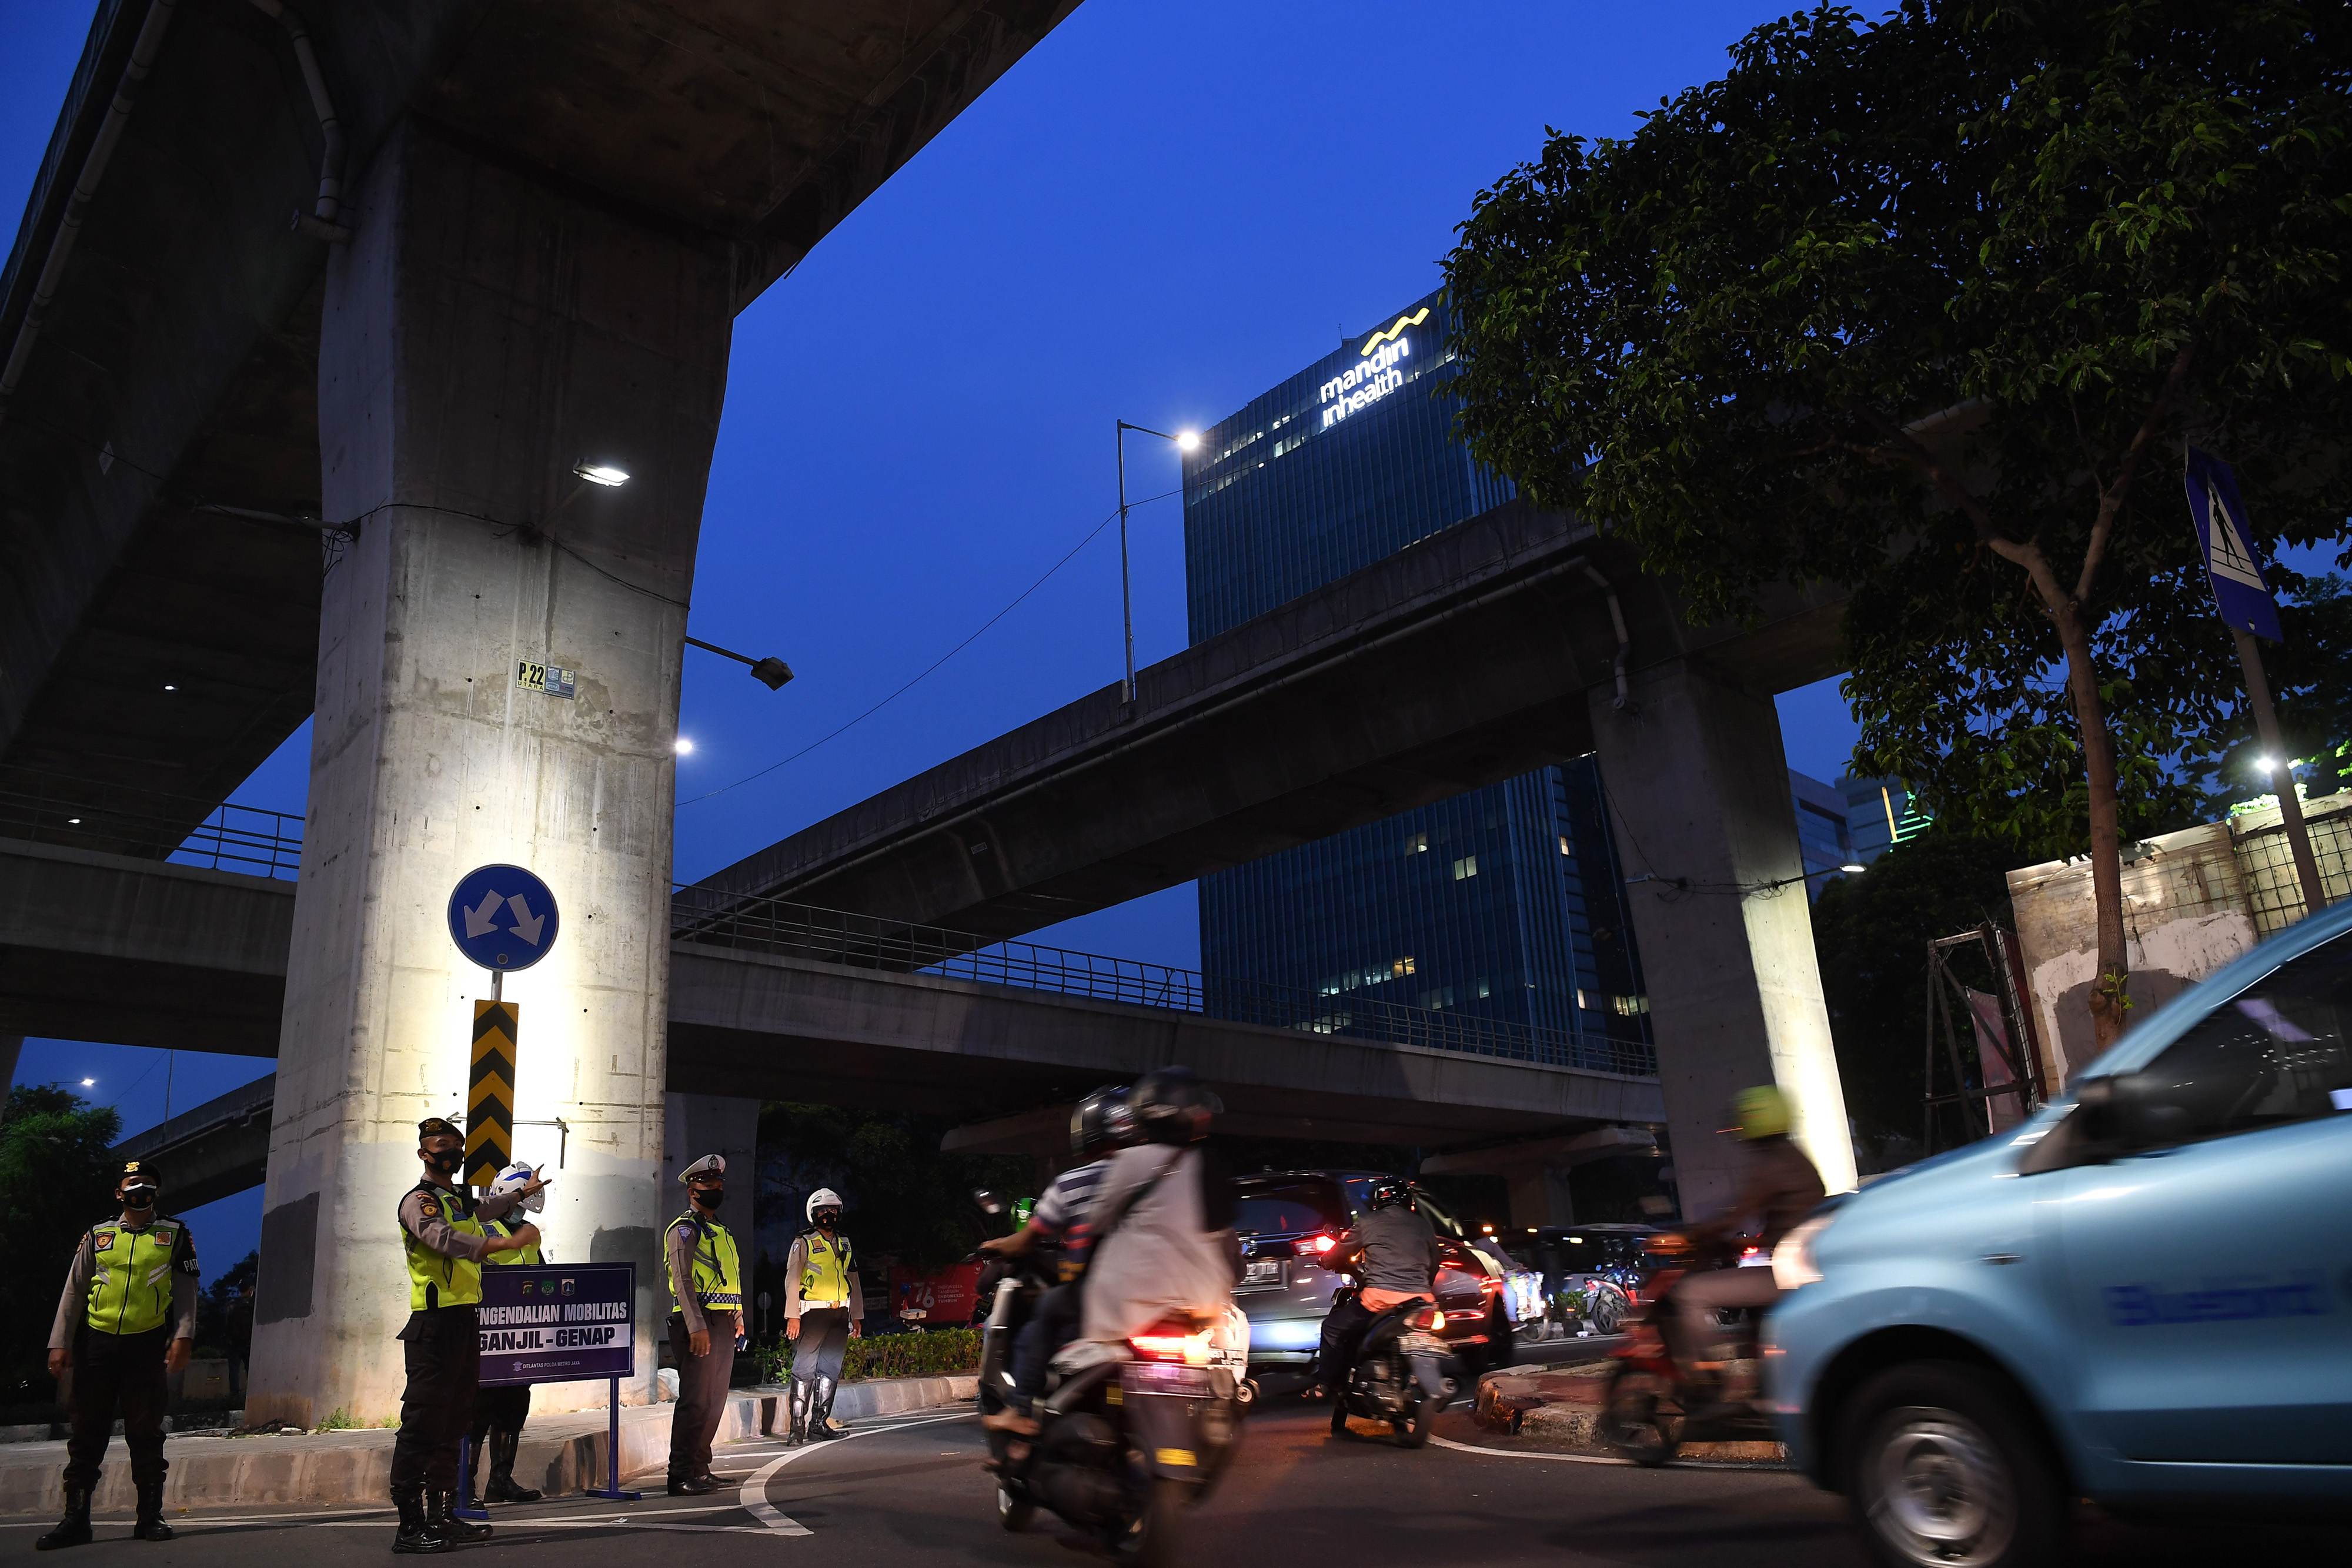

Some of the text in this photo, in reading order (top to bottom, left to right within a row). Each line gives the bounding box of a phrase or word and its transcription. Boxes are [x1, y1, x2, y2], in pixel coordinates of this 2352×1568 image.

[1320, 337, 1409, 404] mandiri
[1322, 366, 1402, 427] inhealth
[517, 681, 544, 691] UTARA
[518, 662, 544, 686] P.22
[913, 1282, 935, 1308] 76
[475, 1302, 627, 1326] NGENDALIAN MOBILITAS
